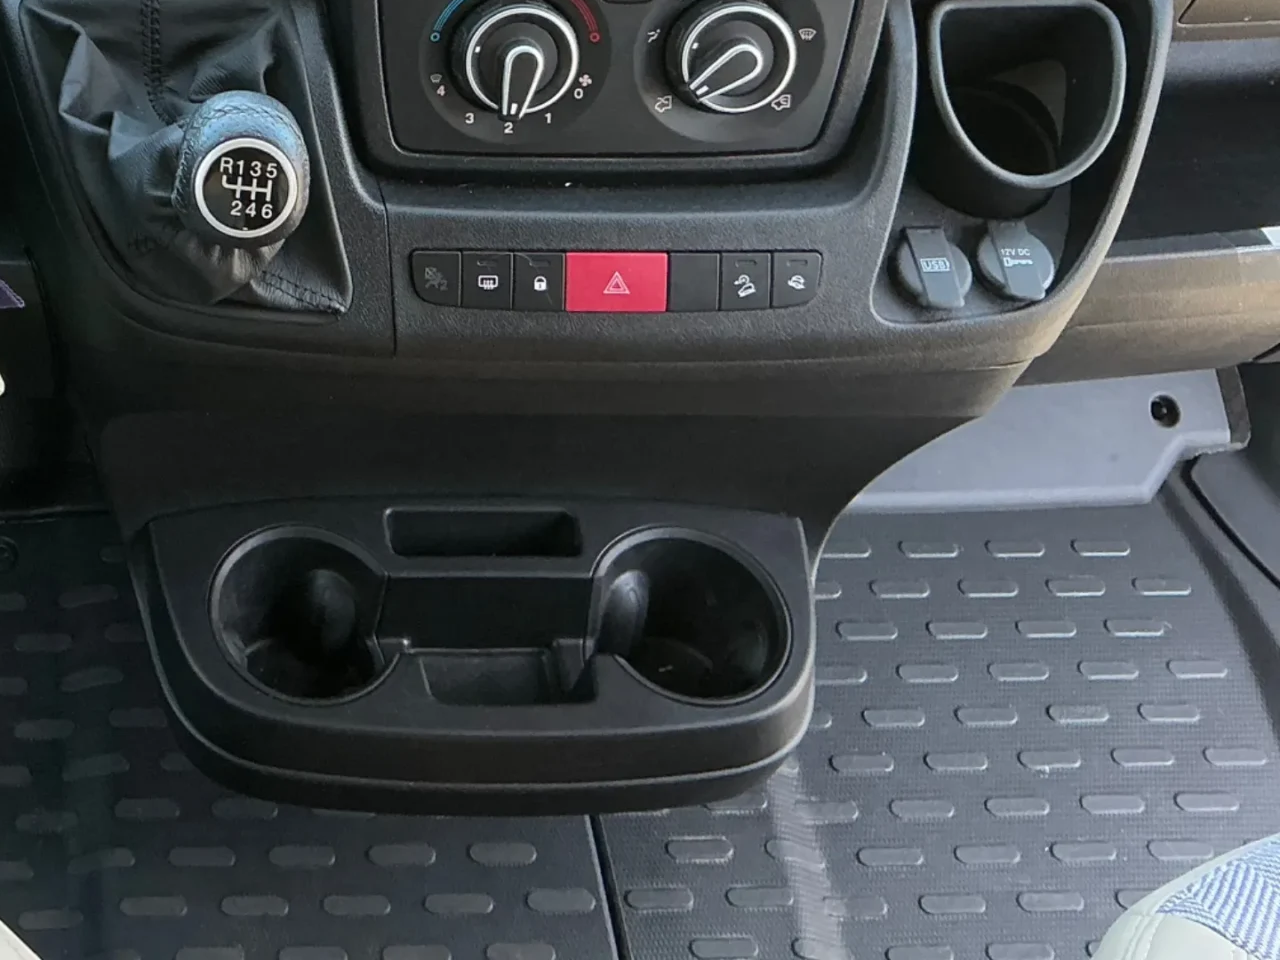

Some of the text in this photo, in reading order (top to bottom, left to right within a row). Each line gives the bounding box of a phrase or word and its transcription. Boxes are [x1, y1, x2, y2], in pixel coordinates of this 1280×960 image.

[436, 85, 446, 97] 4
[574, 88, 584, 99] 0
[465, 113, 475, 124] 3
[544, 113, 552, 124] 1
[504, 122, 514, 134] 2
[220, 157, 278, 179] R 1 3 5
[230, 201, 273, 219] 2 4 6
[1000, 248, 1031, 257] 12V DC
[924, 259, 946, 270] USB
